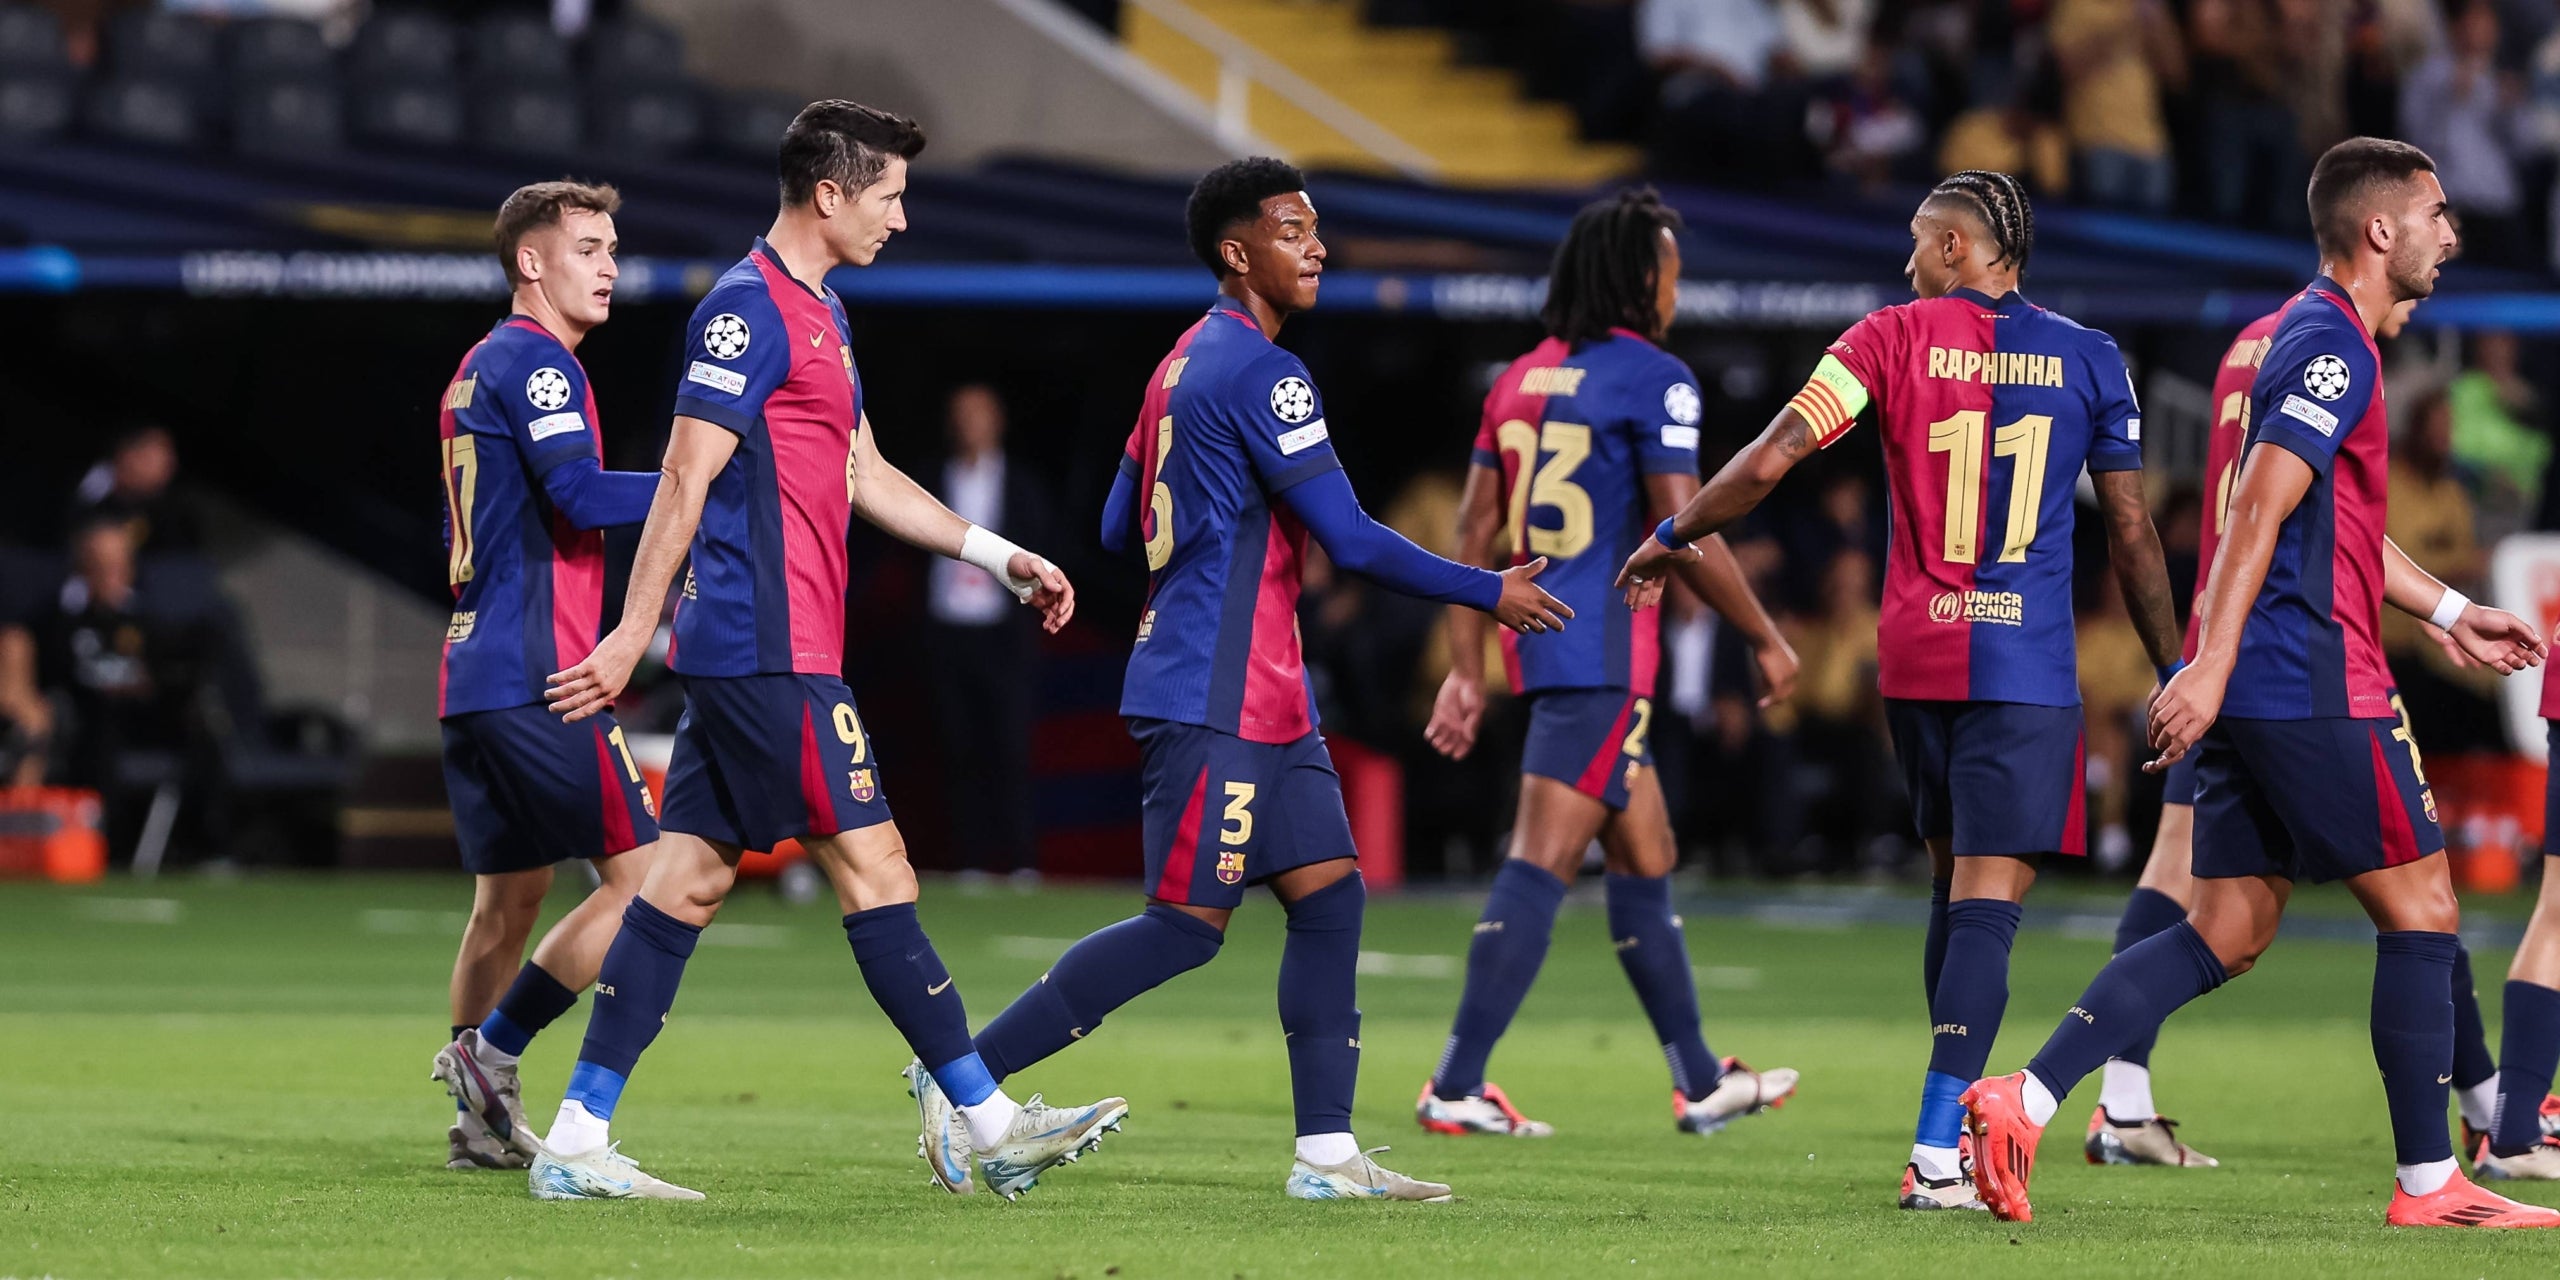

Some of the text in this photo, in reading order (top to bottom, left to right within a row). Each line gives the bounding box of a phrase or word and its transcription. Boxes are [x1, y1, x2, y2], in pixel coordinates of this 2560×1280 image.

[1928, 347, 2063, 388] RAPHINHA
[442, 434, 478, 585] 17
[1928, 410, 2054, 565] 11
[1963, 603, 2022, 621] ACNUR
[1964, 590, 2023, 608] UNHCR
[608, 725, 640, 783] 1
[832, 702, 866, 764] 9
[1220, 781, 1255, 845] 3
